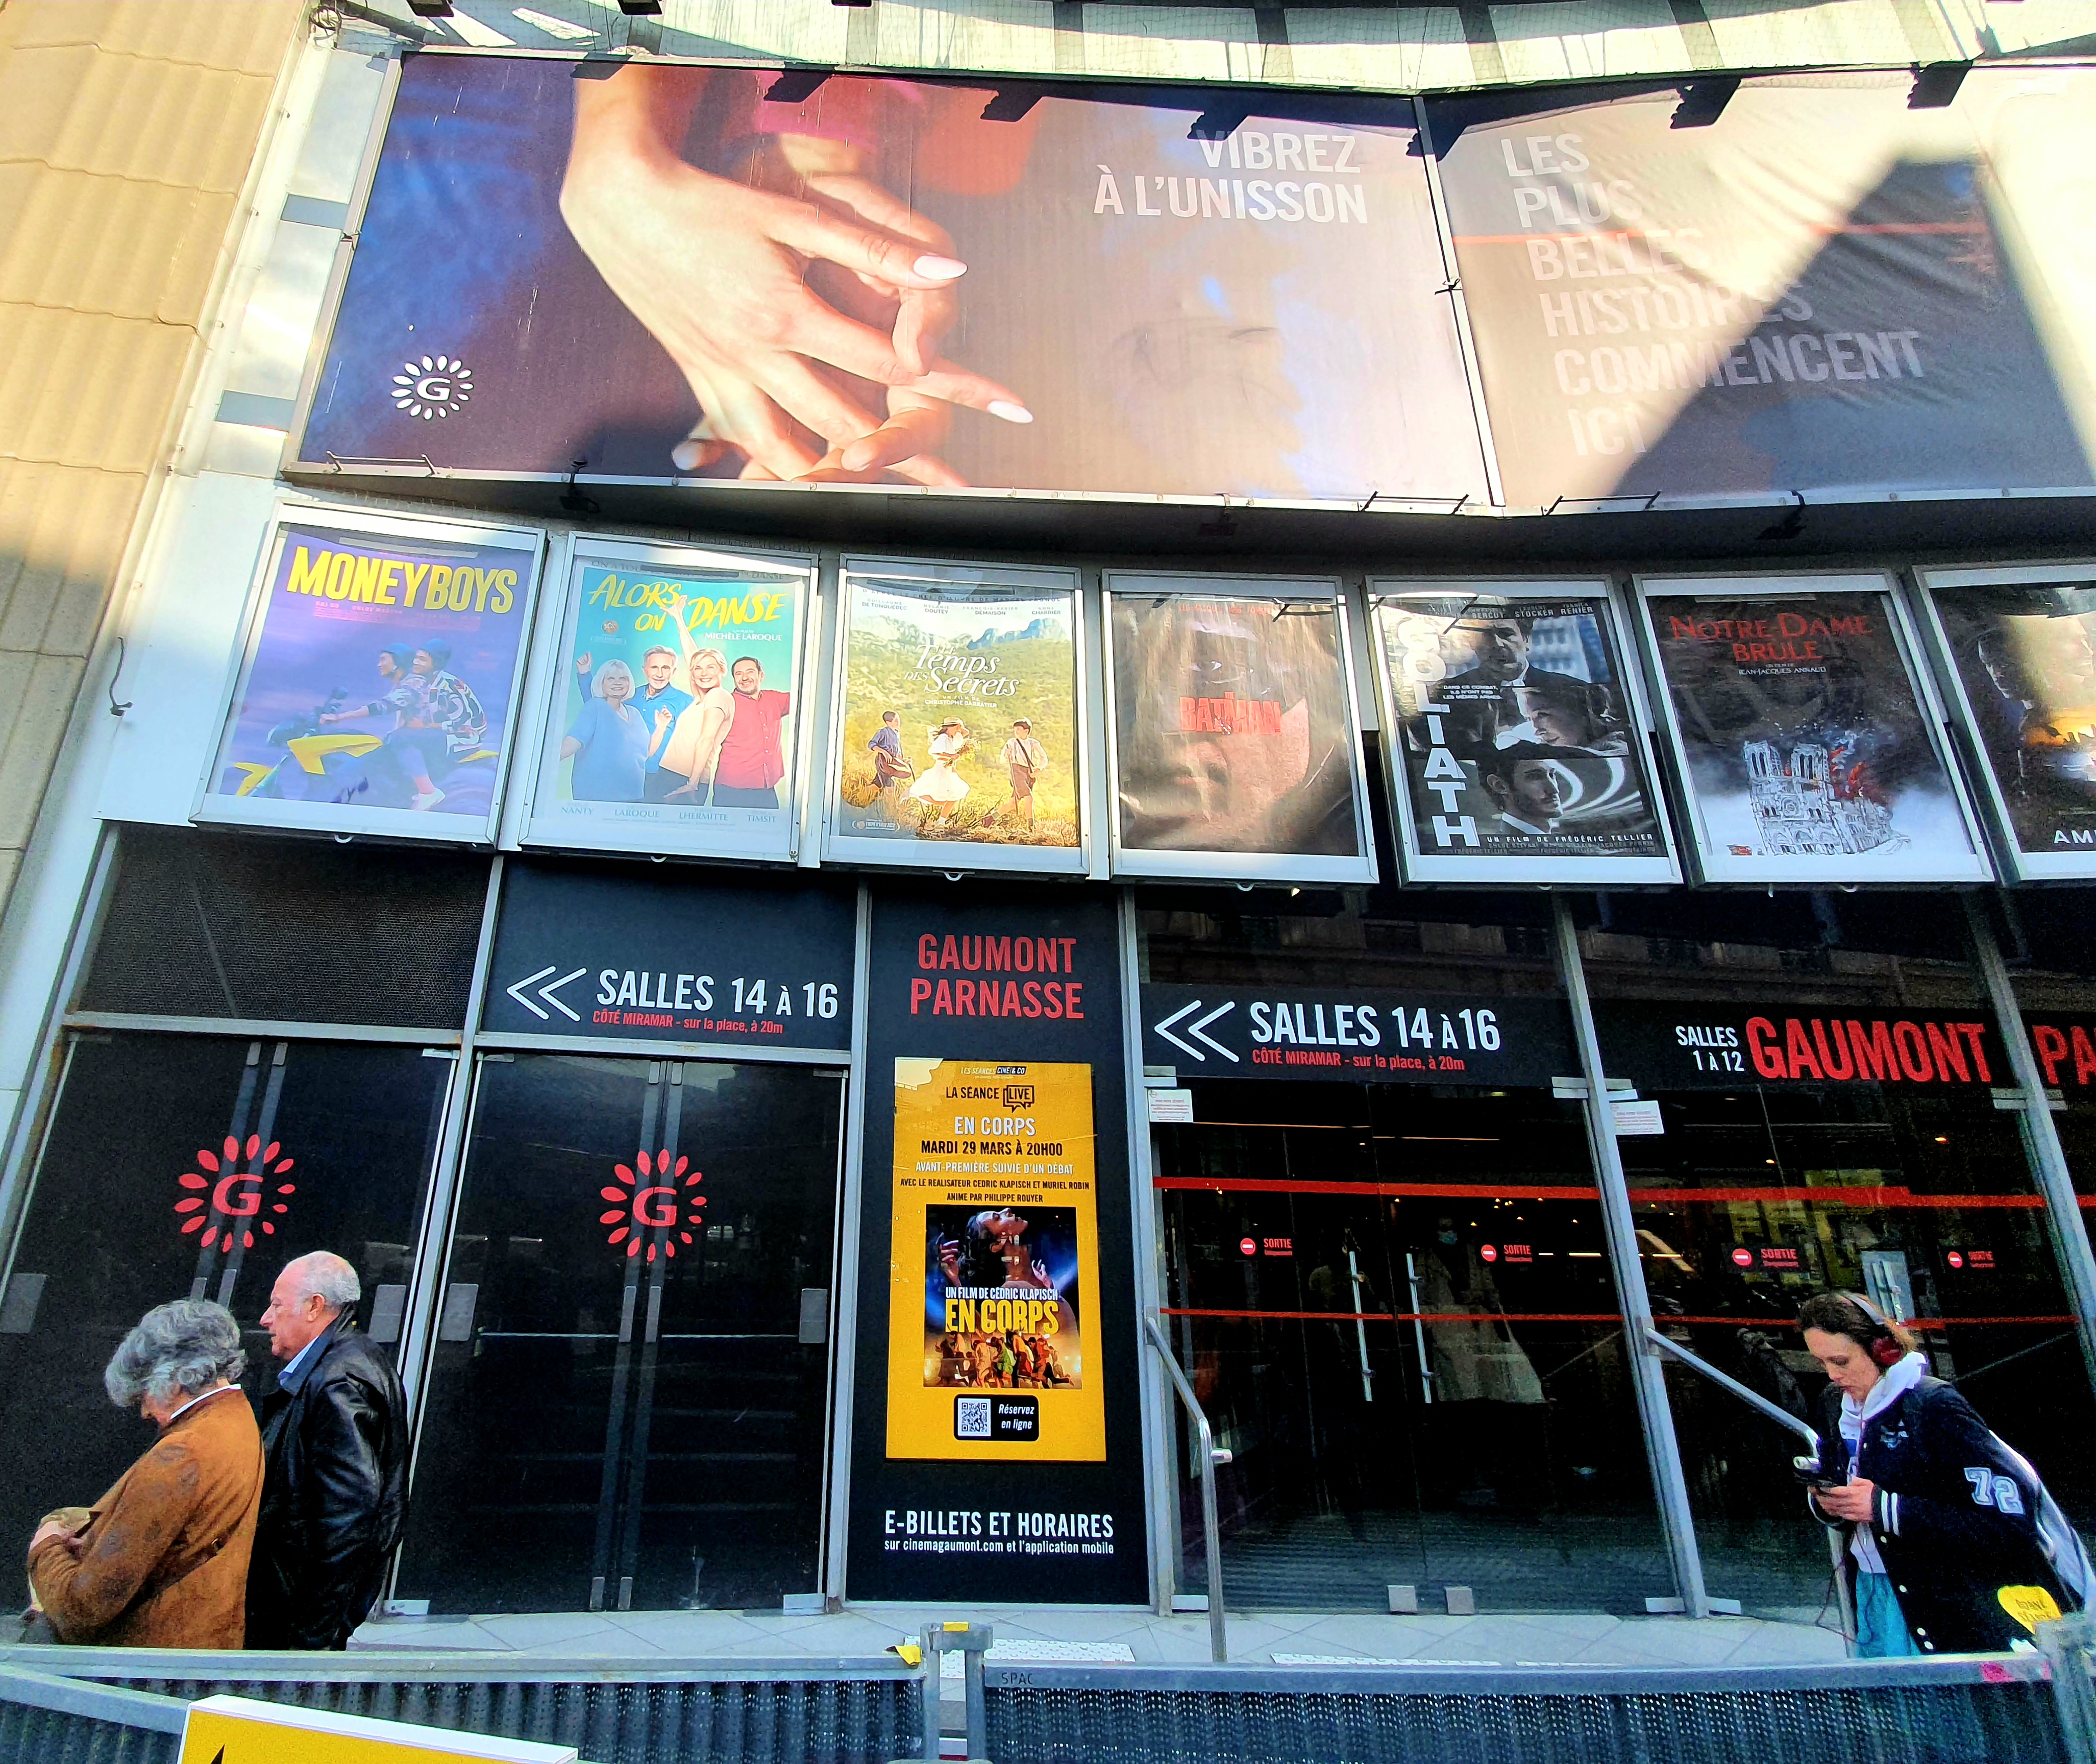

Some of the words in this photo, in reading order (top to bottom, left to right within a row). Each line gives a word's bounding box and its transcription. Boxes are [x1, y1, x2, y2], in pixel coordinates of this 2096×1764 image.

[1196, 129, 1361, 174] VIBREZ
[1501, 133, 1590, 177] LES
[1093, 164, 1124, 214] À
[1134, 175, 1368, 225] L'UNISSON
[1513, 179, 1643, 229] PLUS
[1525, 228, 1715, 281] BELLES
[1553, 330, 1926, 397] COMMENCENT
[1567, 408, 1648, 456] ICI
[286, 546, 518, 614] MONEYBOYS
[589, 574, 683, 611] ALORS
[634, 612, 668, 631] ON
[687, 593, 788, 631] DANSE
[1515, 609, 1555, 619] STOCKER
[1561, 606, 1594, 616] RENIER
[704, 631, 741, 641] MICHÈLE
[742, 632, 783, 642] LAROQUE
[1669, 616, 1773, 640] NOTRE
[1778, 612, 1873, 639] DAME
[913, 644, 1001, 679] Temps
[903, 671, 930, 681] DES
[924, 666, 1020, 697] Secrets
[1179, 696, 1283, 735] BATMAN
[1397, 617, 1481, 847] GOLIATH
[561, 806, 594, 816] NANTY
[614, 809, 659, 818] LAROQUE
[679, 812, 729, 821] LHERMITTE
[748, 815, 777, 823] TIMSIT
[1555, 834, 1604, 843] FRÉDÉRIC
[1611, 833, 1654, 841] TELLIER
[918, 933, 1077, 974] GAUMONT
[596, 969, 714, 1012] SALLES
[731, 977, 768, 1015] 14
[775, 985, 793, 1016] À
[802, 982, 839, 1019] 16
[910, 978, 1085, 1019] PARNASSE
[593, 1008, 621, 1025] CÔTÉ
[622, 1012, 674, 1028] MIRAMAR
[683, 1019, 702, 1030] sur
[703, 1017, 714, 1030] la
[717, 1019, 749, 1034] place,
[750, 1021, 758, 1033] à
[760, 1020, 784, 1034] 20m
[1250, 1001, 1381, 1048] SALLES
[1391, 1007, 1434, 1049] 14
[1442, 1014, 1459, 1050] À
[1458, 1009, 1501, 1051] 16
[1675, 1026, 1739, 1048] SALLES
[1745, 1016, 1993, 1083] GAUMONT
[2032, 1024, 2096, 1085] PA
[1252, 1046, 1283, 1065] CÔTÉ
[1285, 1050, 1342, 1067] MIRAMAR
[1353, 1057, 1372, 1067] sur
[1375, 1054, 1388, 1068] la
[1390, 1055, 1426, 1071] place,
[1428, 1057, 1437, 1070] à
[1439, 1056, 1465, 1071] 20m
[1692, 1050, 1703, 1071] 1
[1709, 1053, 1719, 1071] À
[1724, 1051, 1744, 1072] 12
[946, 1087, 958, 1099] LA
[960, 1085, 1000, 1099] SÉANCE
[1009, 1088, 1030, 1100] LIVE
[954, 1116, 975, 1135] EN
[981, 1116, 1036, 1136] CORPS
[921, 1140, 958, 1154] MARDI
[962, 1141, 975, 1155] 29
[980, 1141, 1012, 1155] MARS
[1016, 1139, 1023, 1155] À
[1026, 1142, 1063, 1157] 20H00
[916, 1160, 990, 1173] AVANT-PREMIÈRE
[993, 1162, 1021, 1173] SUIVIE
[1024, 1163, 1045, 1174] D'UN
[1047, 1162, 1074, 1175] DÉBAT
[900, 1178, 917, 1187] AVEC
[919, 1179, 927, 1187] LE
[973, 1180, 997, 1188] CEDRIC
[999, 1180, 1031, 1189] KLAPISCH
[1033, 1181, 1041, 1189] ET
[1042, 1181, 1068, 1189] MURIEL
[1069, 1181, 1090, 1190] ROBIN
[947, 1192, 968, 1202] ANIME
[969, 1193, 983, 1202] PAR
[984, 1193, 1016, 1203] PHILIPPE
[1017, 1193, 1043, 1203] ROUYER
[1263, 1238, 1292, 1248] SORTIE
[1503, 1244, 1532, 1255] SORTIE
[1760, 1248, 1797, 1259] SORTIE
[946, 1286, 957, 1299] UN
[958, 1287, 978, 1300] FILM
[979, 1287, 989, 1300] DE
[990, 1286, 1018, 1301] CÉDRIC
[1020, 1288, 1058, 1301] KLAPISCH
[945, 1299, 976, 1333] EN
[981, 1299, 1059, 1335] CORPS
[998, 1404, 1035, 1415] Réservez
[1001, 1419, 1012, 1429] en
[1013, 1418, 1032, 1431] ligne
[1964, 1467, 2026, 1514] 72
[884, 1510, 982, 1535] E-BILLETS
[989, 1512, 1011, 1536] ET
[1017, 1512, 1114, 1538] HORAIRES
[884, 1539, 900, 1550] sur
[903, 1538, 1004, 1553] cinemagaumont.com
[1006, 1540, 1017, 1552] et
[1019, 1540, 1079, 1556] l'application
[1081, 1542, 1114, 1555] mobile
[1001, 1672, 1033, 1685] SPAC
